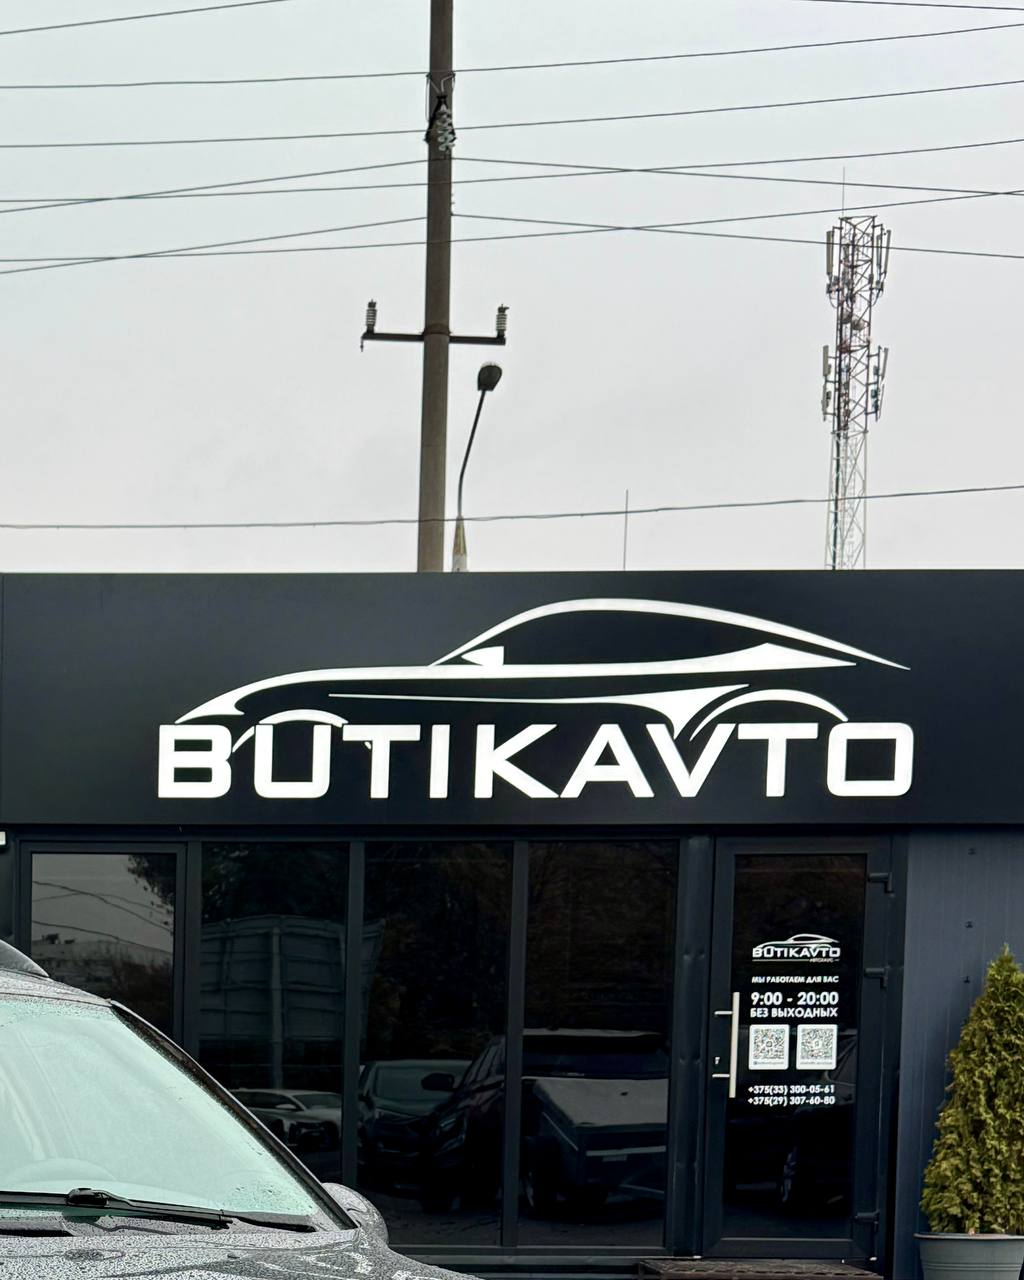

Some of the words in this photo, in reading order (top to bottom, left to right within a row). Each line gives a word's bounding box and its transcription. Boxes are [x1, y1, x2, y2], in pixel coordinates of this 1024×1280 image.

[157, 721, 914, 800] BUTIKAVTO
[752, 947, 841, 958] BUTIKAVTO
[806, 976, 822, 984] ДЛЯ
[751, 992, 783, 1005] 9:00
[797, 992, 839, 1005] 20:00
[750, 1007, 769, 1018] БЕЗ
[771, 1007, 838, 1019] ВЫХОДНЫХ
[748, 1085, 788, 1095] +375(33)
[790, 1085, 835, 1094] 300-05-61
[748, 1096, 788, 1106] +375(29)
